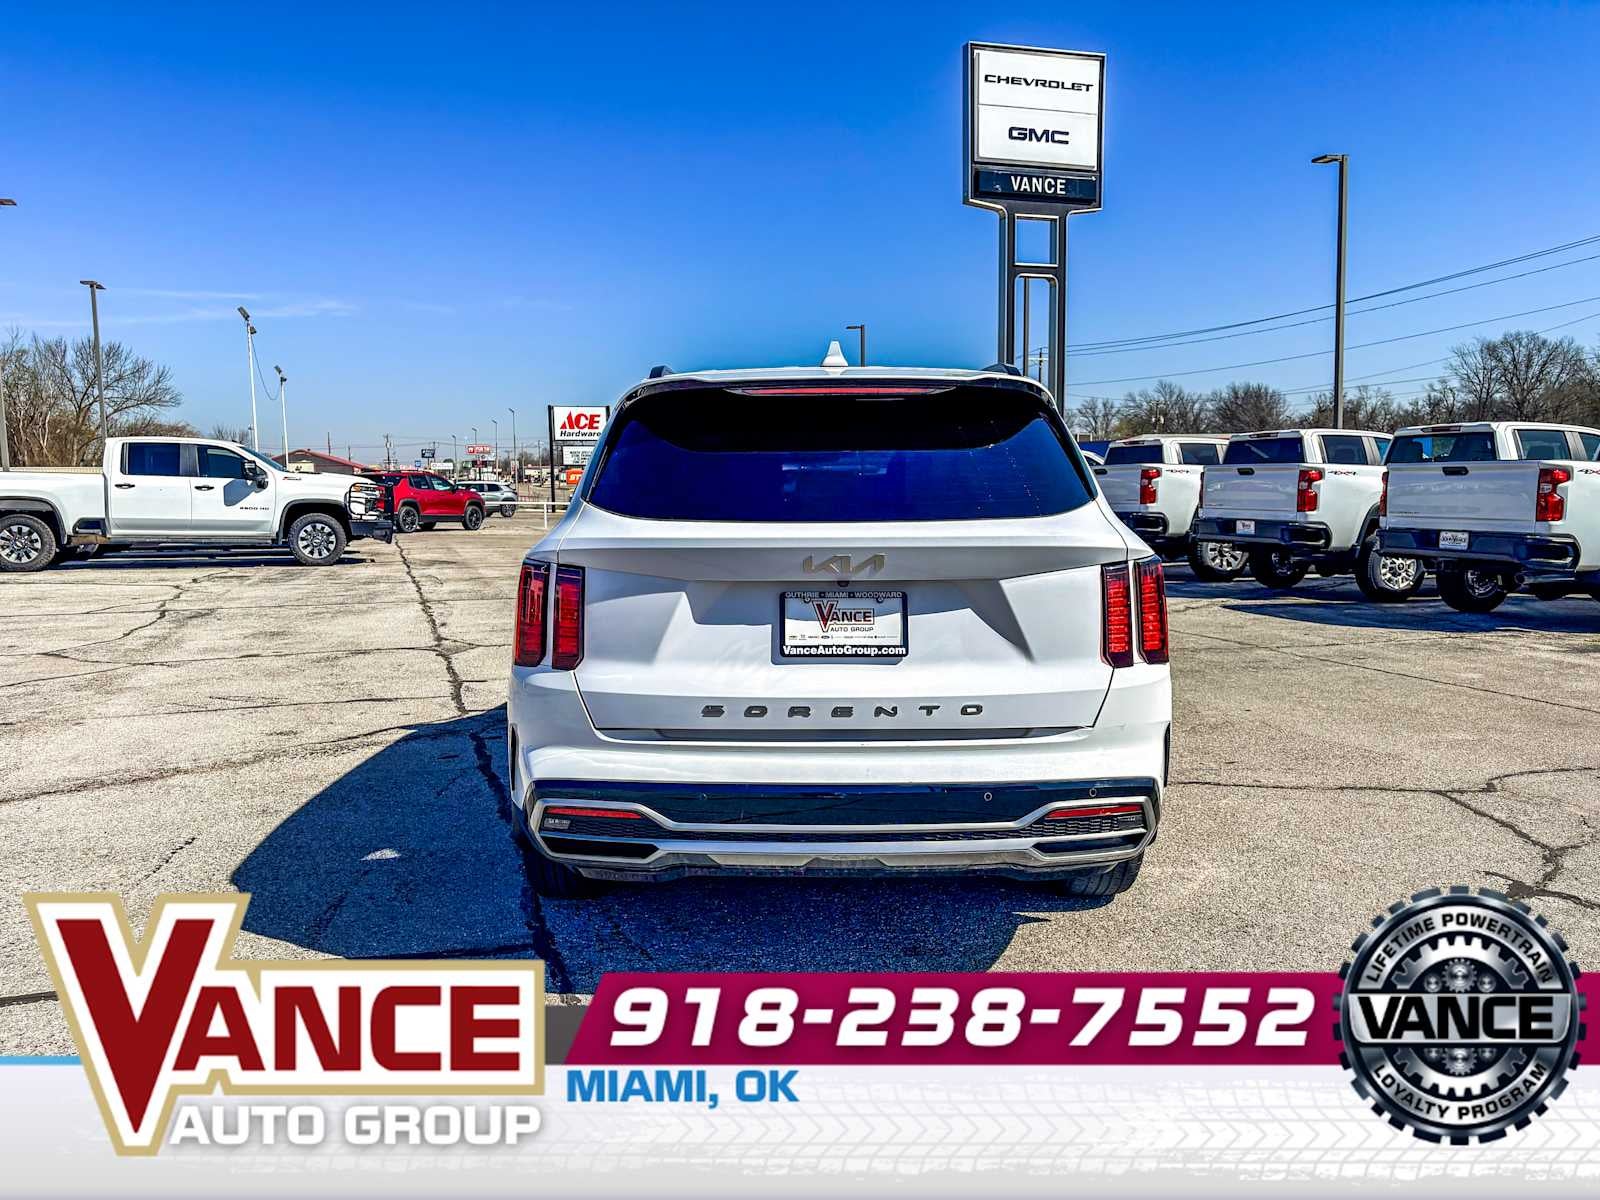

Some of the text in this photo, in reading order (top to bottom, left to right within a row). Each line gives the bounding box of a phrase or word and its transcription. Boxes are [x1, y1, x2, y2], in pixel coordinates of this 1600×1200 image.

[984, 74, 1094, 92] CHEVROLET
[1008, 126, 1070, 145] GMC
[1010, 175, 1067, 195] VANCE
[560, 411, 601, 430] ACE
[783, 645, 906, 656] VanceAutoGroup.com
[700, 704, 983, 718] SORENTO
